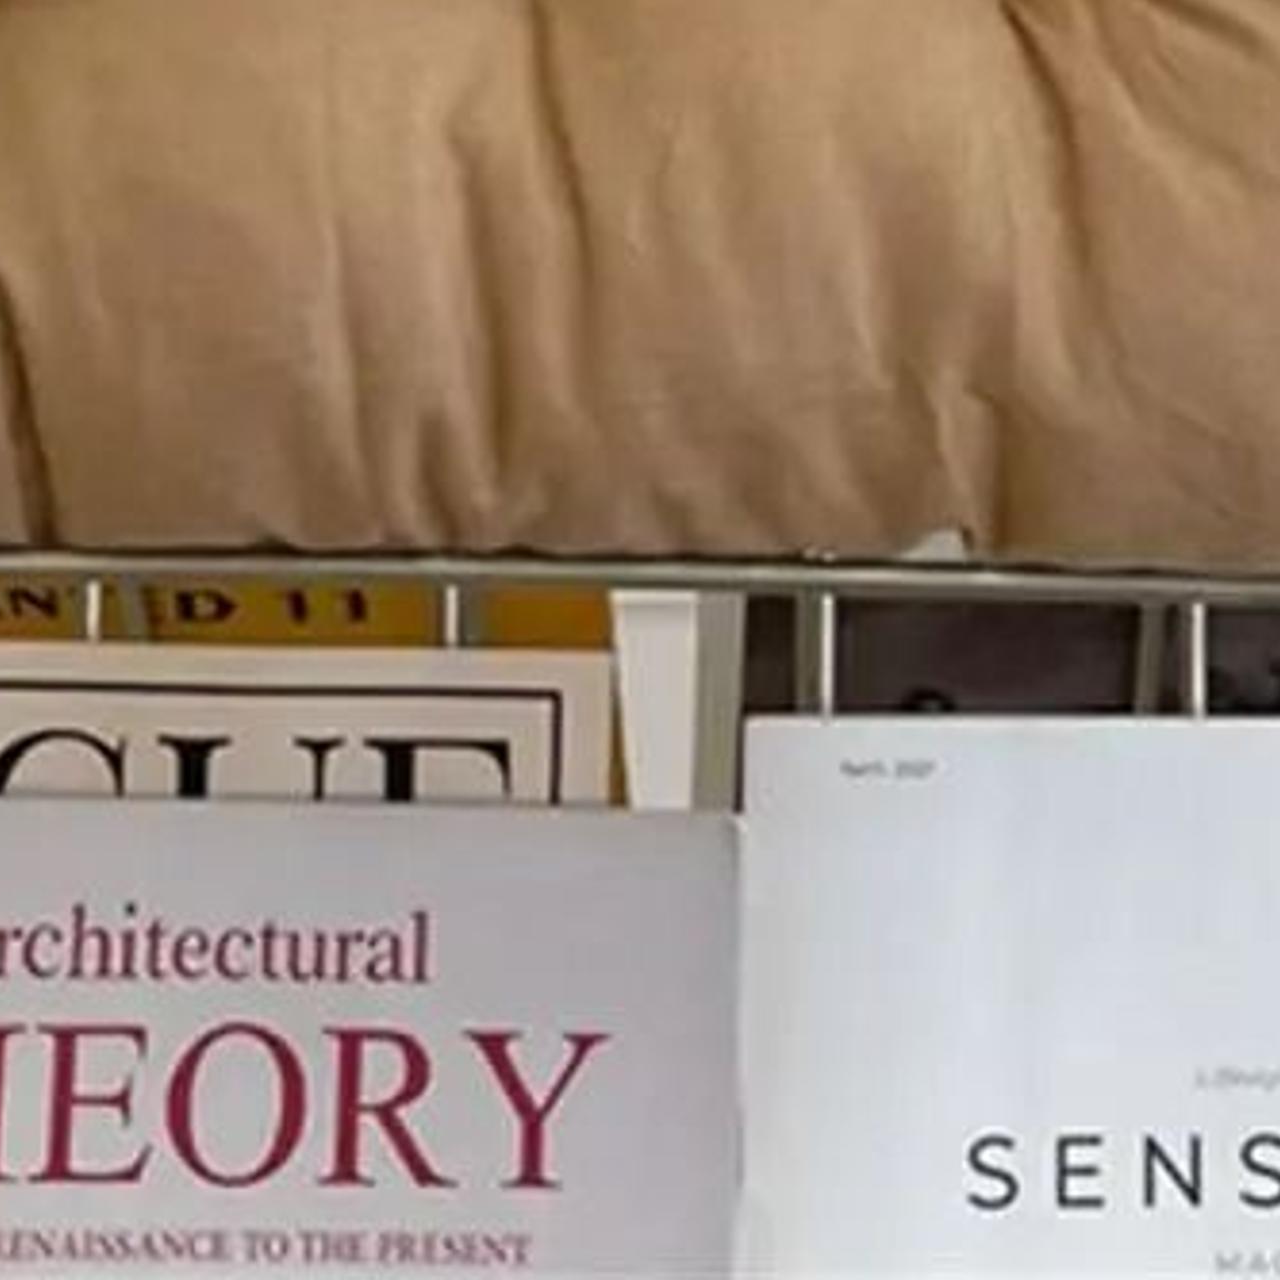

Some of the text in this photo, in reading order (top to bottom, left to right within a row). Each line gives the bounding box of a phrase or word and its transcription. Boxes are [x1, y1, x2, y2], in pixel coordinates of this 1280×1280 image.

[241, 1230, 293, 1263] TO
[297, 1230, 368, 1264] THE
[376, 1231, 532, 1266] PRESENT
